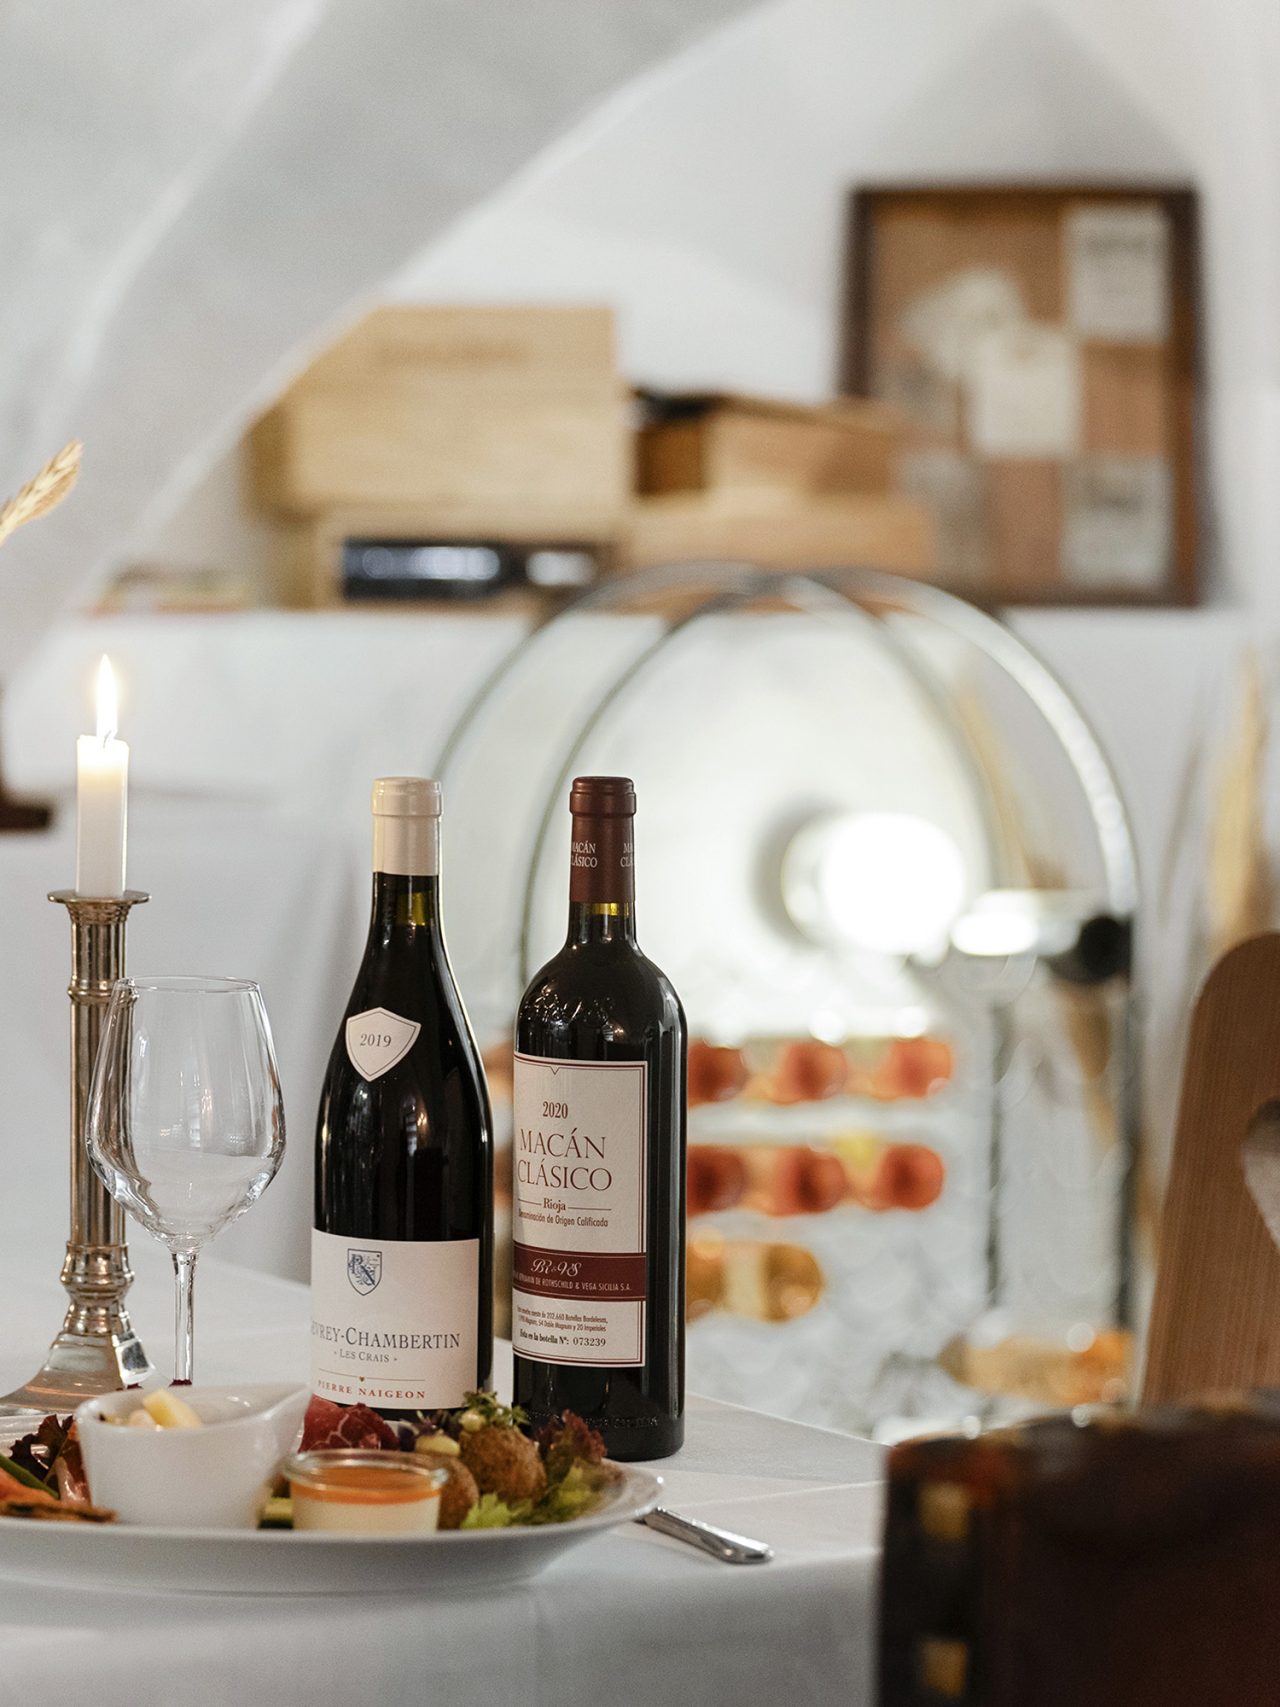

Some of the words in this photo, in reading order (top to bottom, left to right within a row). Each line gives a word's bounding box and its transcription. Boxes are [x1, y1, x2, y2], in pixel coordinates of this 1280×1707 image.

[571, 853, 598, 868] LÁSICO
[360, 1033, 392, 1048] 2019
[542, 1101, 569, 1119] 2020
[519, 1127, 607, 1159] MACÁN
[517, 1158, 613, 1192] CLÁSICO
[543, 1197, 567, 1214] Rioja
[546, 1213, 554, 1224] de
[555, 1214, 575, 1228] Origen
[576, 1216, 609, 1227] Calificada
[535, 1277, 542, 1286] DE
[542, 1278, 574, 1290] ROTHSCHILD
[581, 1282, 597, 1291] VEGA
[598, 1283, 620, 1292] SICILIA
[311, 1321, 460, 1349] EVREY-CHAMBERTIN
[539, 1334, 558, 1344] botella
[573, 1337, 606, 1347] 073239
[340, 1349, 356, 1360] LES
[358, 1351, 390, 1363] CRAIS
[318, 1380, 353, 1394] PIERRE
[358, 1387, 426, 1399] NAIGEON
